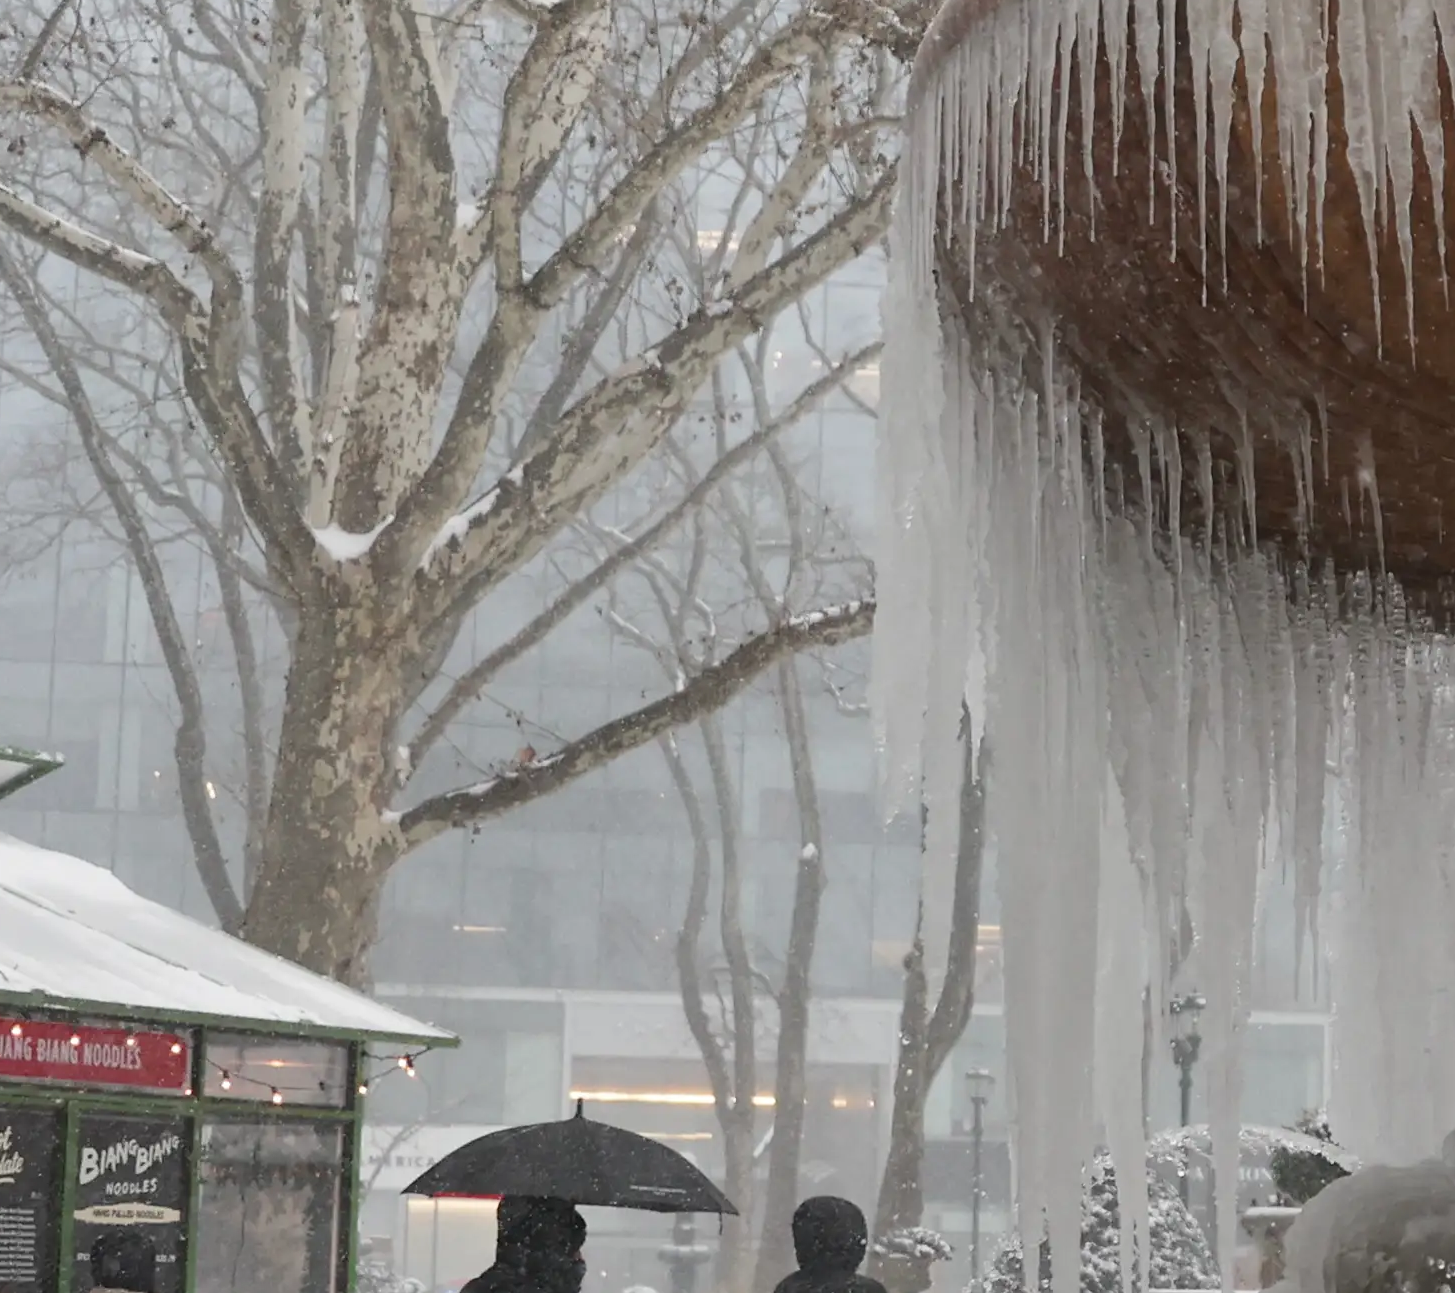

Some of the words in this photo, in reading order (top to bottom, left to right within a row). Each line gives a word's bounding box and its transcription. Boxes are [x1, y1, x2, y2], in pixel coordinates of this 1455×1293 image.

[37, 1037, 78, 1065] BIANG
[83, 1042, 142, 1070] NOODLES
[79, 1139, 139, 1185] BIANG
[135, 1135, 181, 1175] BIANG
[106, 1178, 158, 1195] NOODLES
